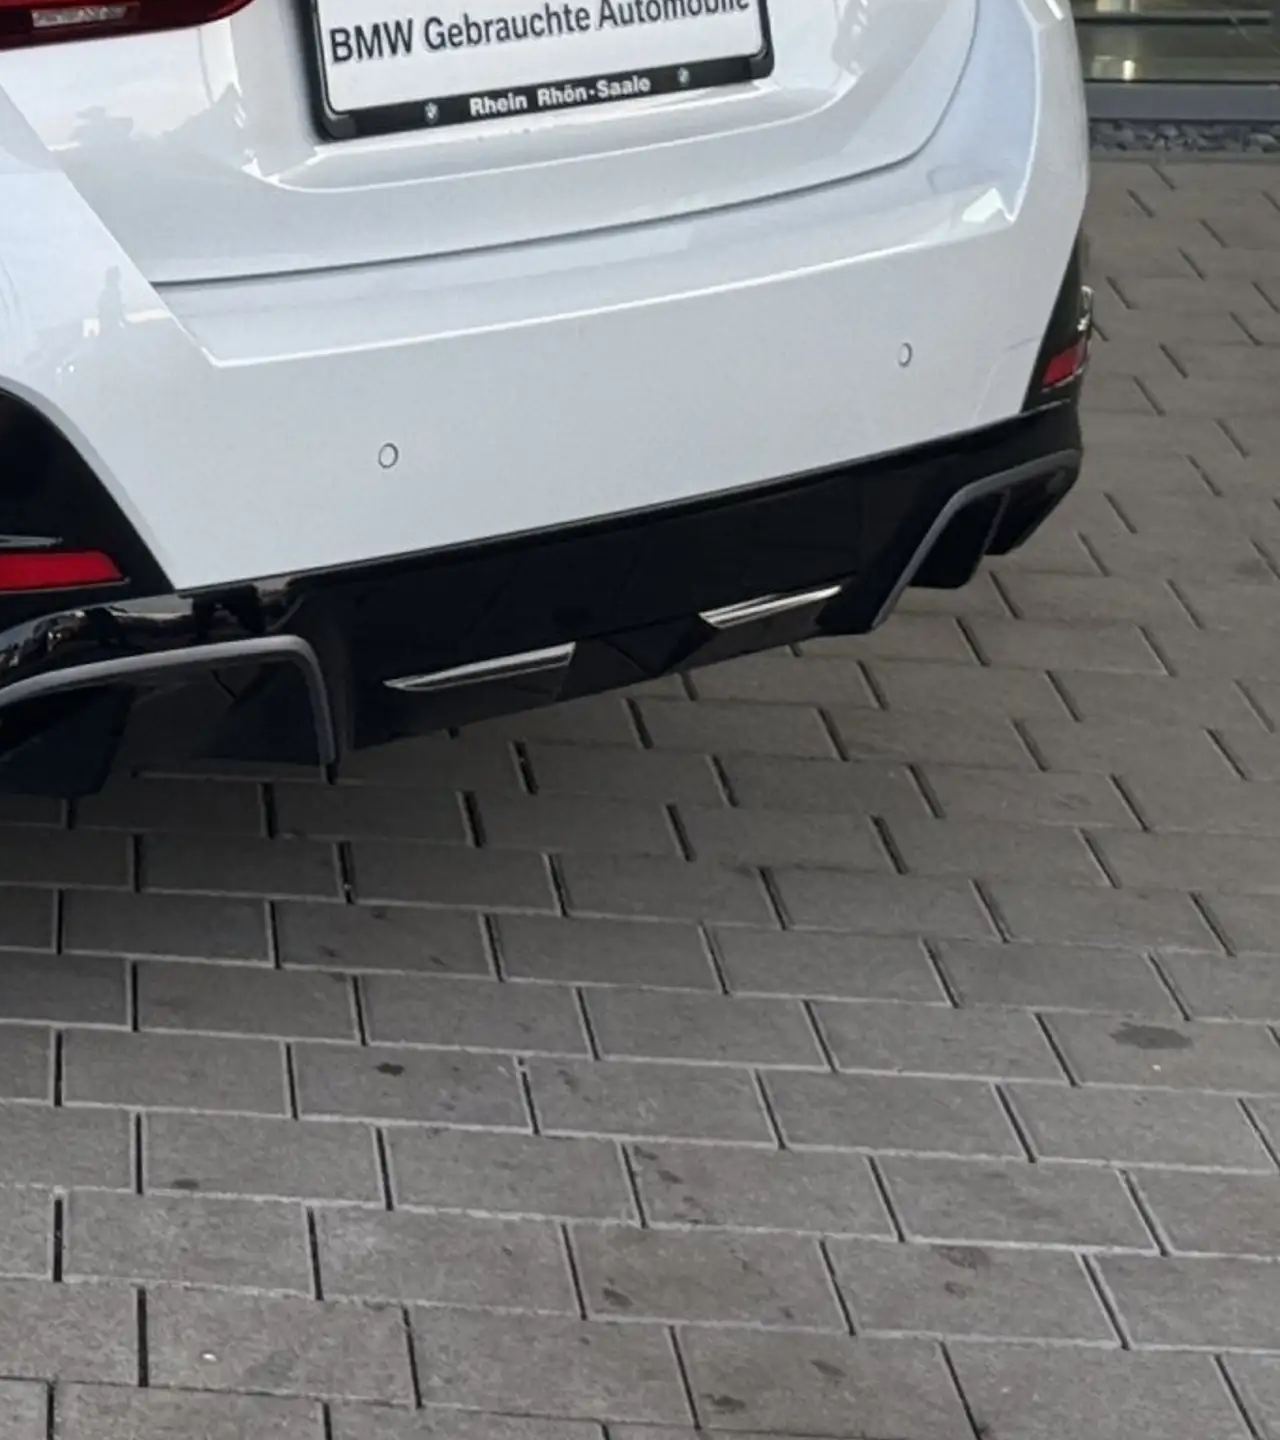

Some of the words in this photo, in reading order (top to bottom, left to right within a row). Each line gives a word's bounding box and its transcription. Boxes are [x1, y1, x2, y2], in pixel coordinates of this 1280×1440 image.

[329, 19, 414, 63] BMW
[423, 2, 592, 52] Gebrauchte
[469, 92, 528, 117] Rhein
